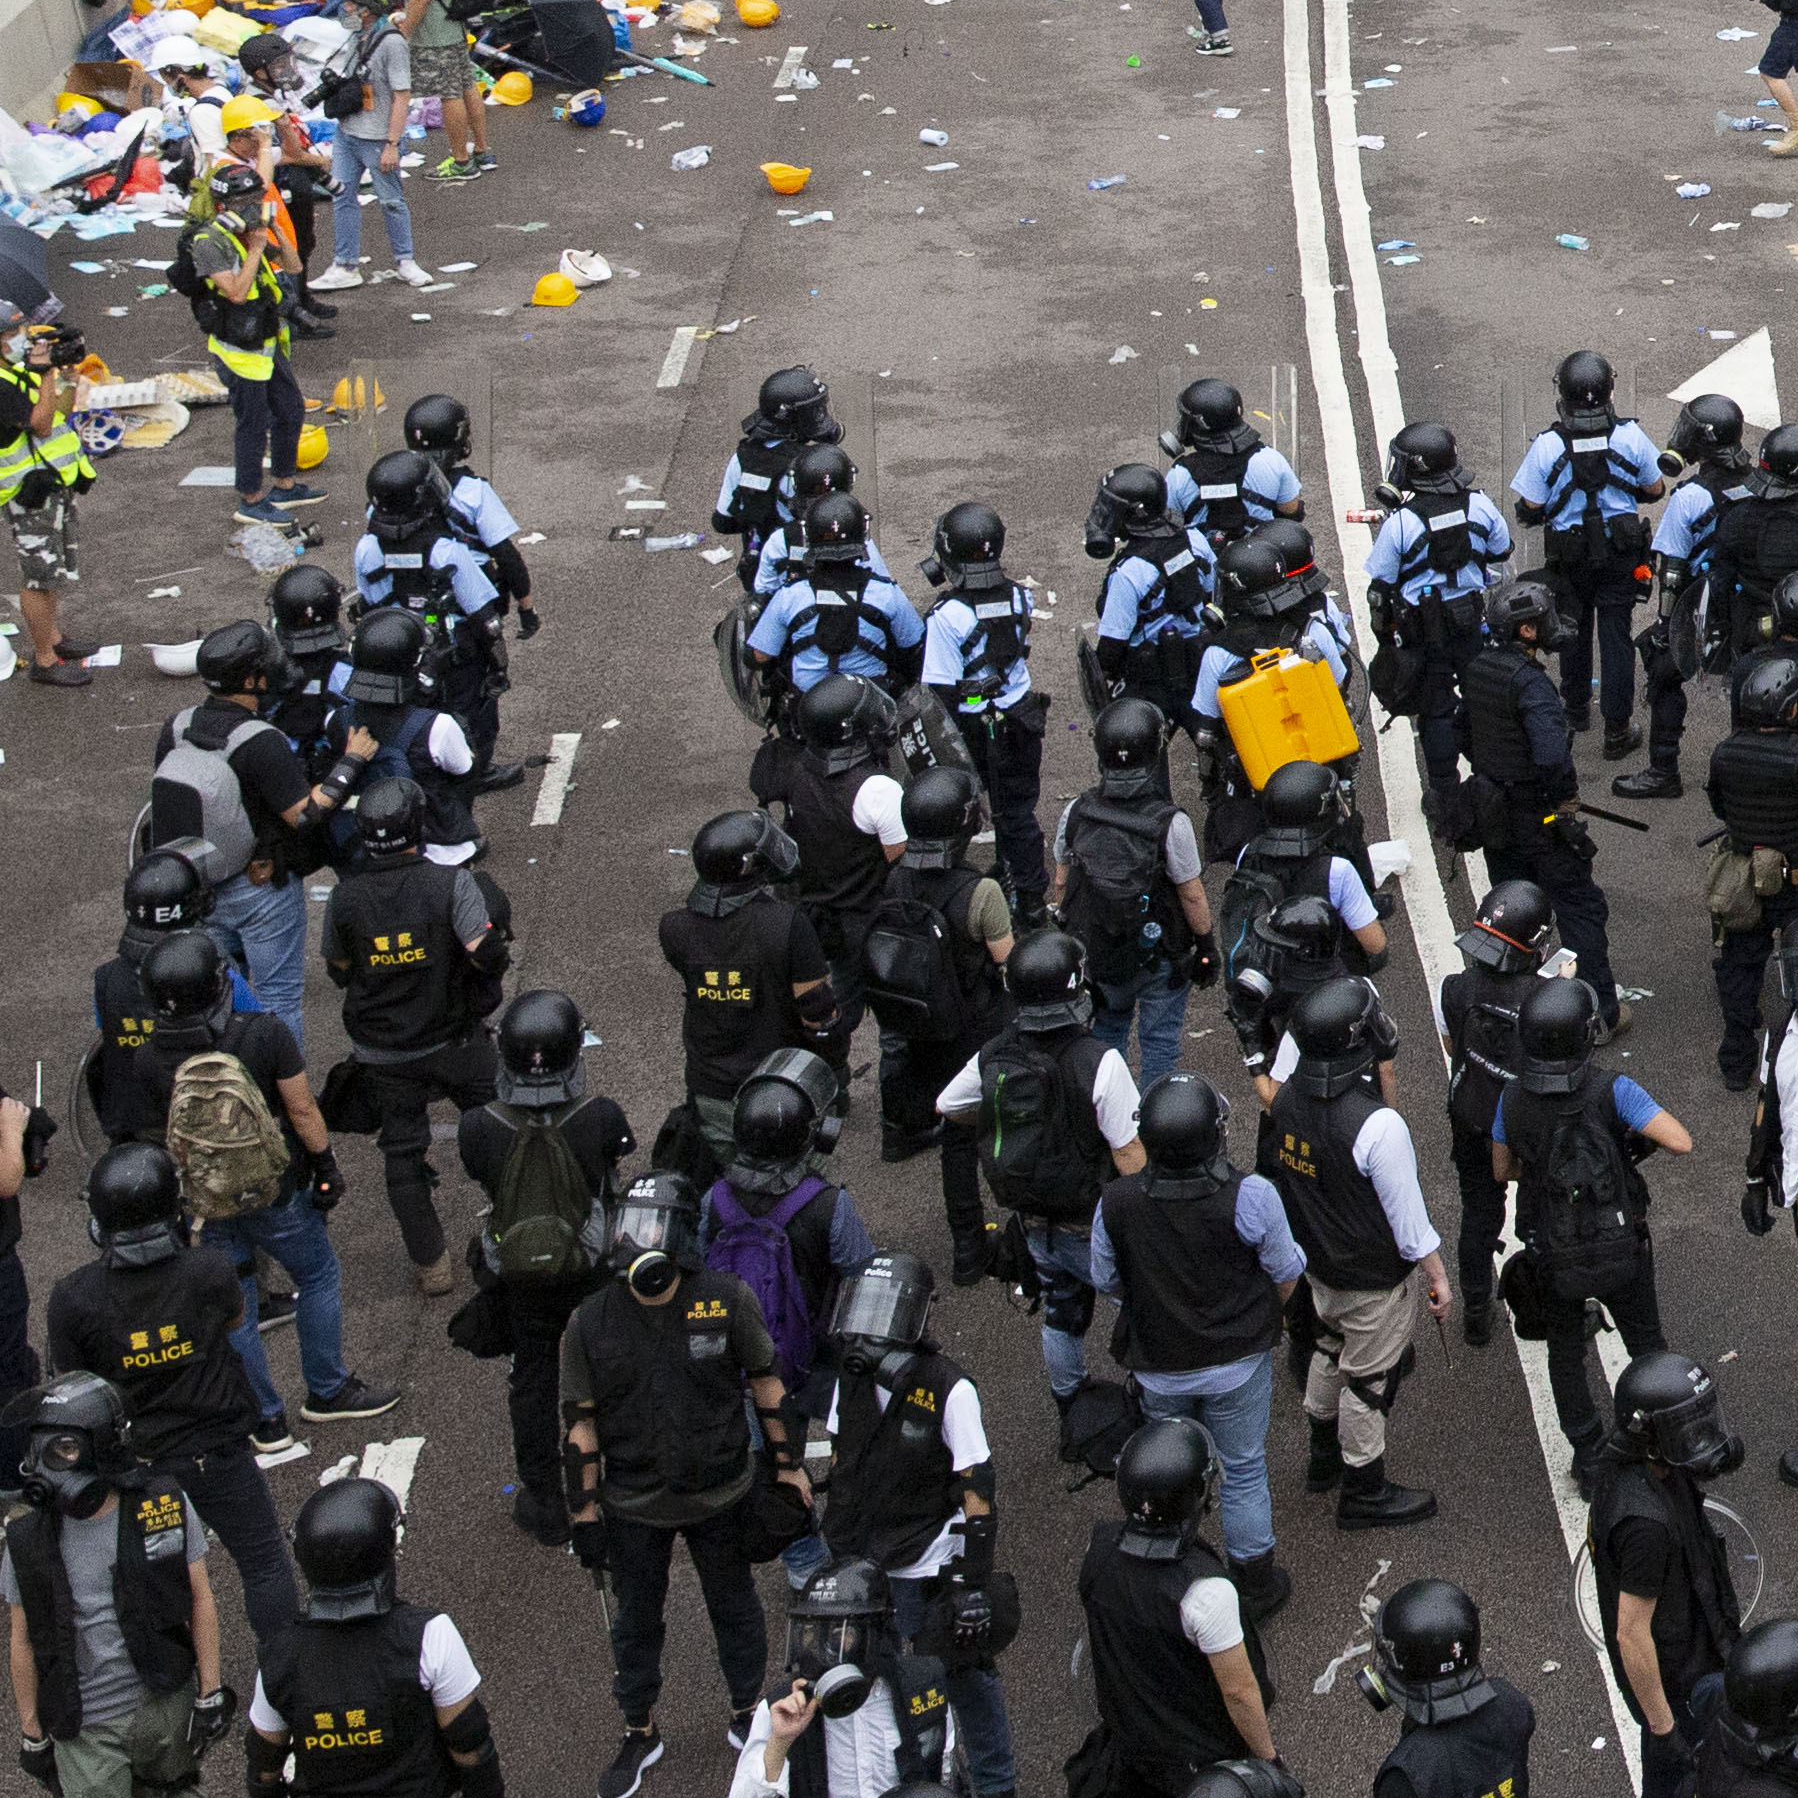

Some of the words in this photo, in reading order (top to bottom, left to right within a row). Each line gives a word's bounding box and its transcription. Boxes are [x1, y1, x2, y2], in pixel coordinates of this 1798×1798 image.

[912, 716, 937, 768] LICE
[155, 904, 182, 923] E4
[370, 947, 426, 967] POLICE
[1067, 973, 1077, 989] 4
[698, 987, 751, 1002] POLICE
[1279, 1148, 1317, 1178] POLICE
[864, 1268, 892, 1279] Police
[687, 1308, 728, 1320] POLICE
[123, 1340, 194, 1368] POLICE
[137, 1501, 181, 1520] POLICE
[313, 1708, 366, 1729] 警察
[304, 1728, 384, 1750] POLICE
